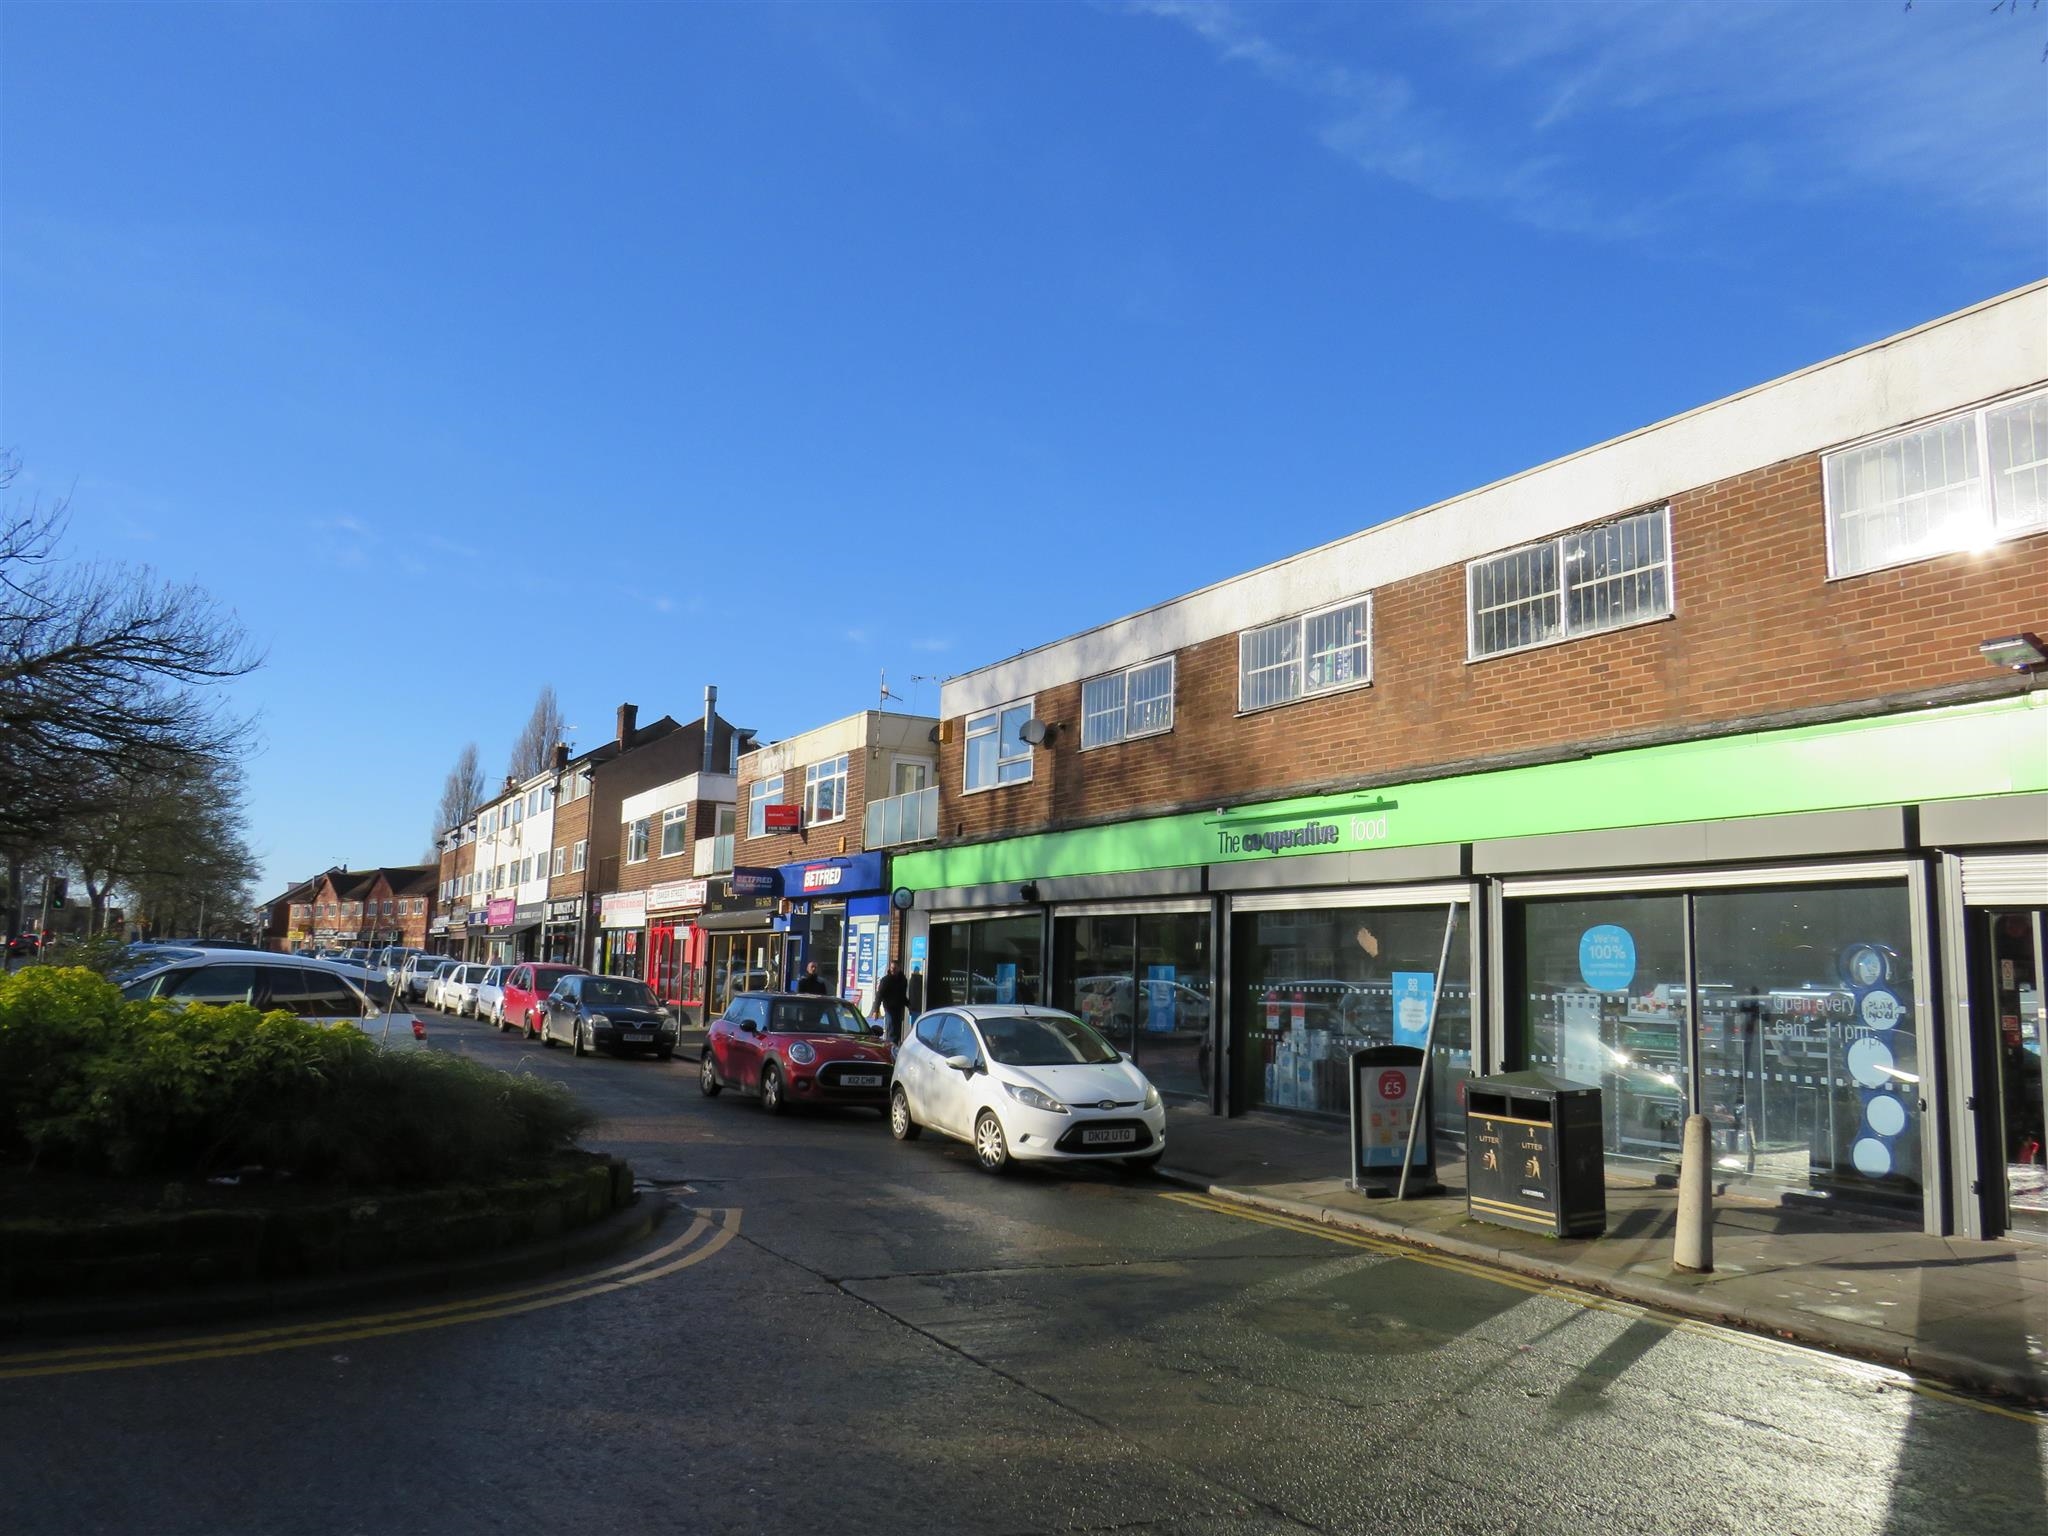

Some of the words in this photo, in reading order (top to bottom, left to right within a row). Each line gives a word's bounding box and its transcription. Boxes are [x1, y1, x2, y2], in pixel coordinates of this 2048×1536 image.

[1217, 831, 1241, 854] The
[1351, 811, 1387, 842] food
[735, 874, 774, 884] BETFRED
[803, 867, 841, 888] BETFRED
[1588, 944, 1627, 960] 100%
[1773, 995, 1811, 1012] Open
[1816, 997, 1856, 1016] every
[1775, 1019, 1807, 1037] 6am
[1384, 1081, 1402, 1095] £5
[1479, 1135, 1500, 1144] LITTER
[1521, 1142, 1543, 1151] LITTER
